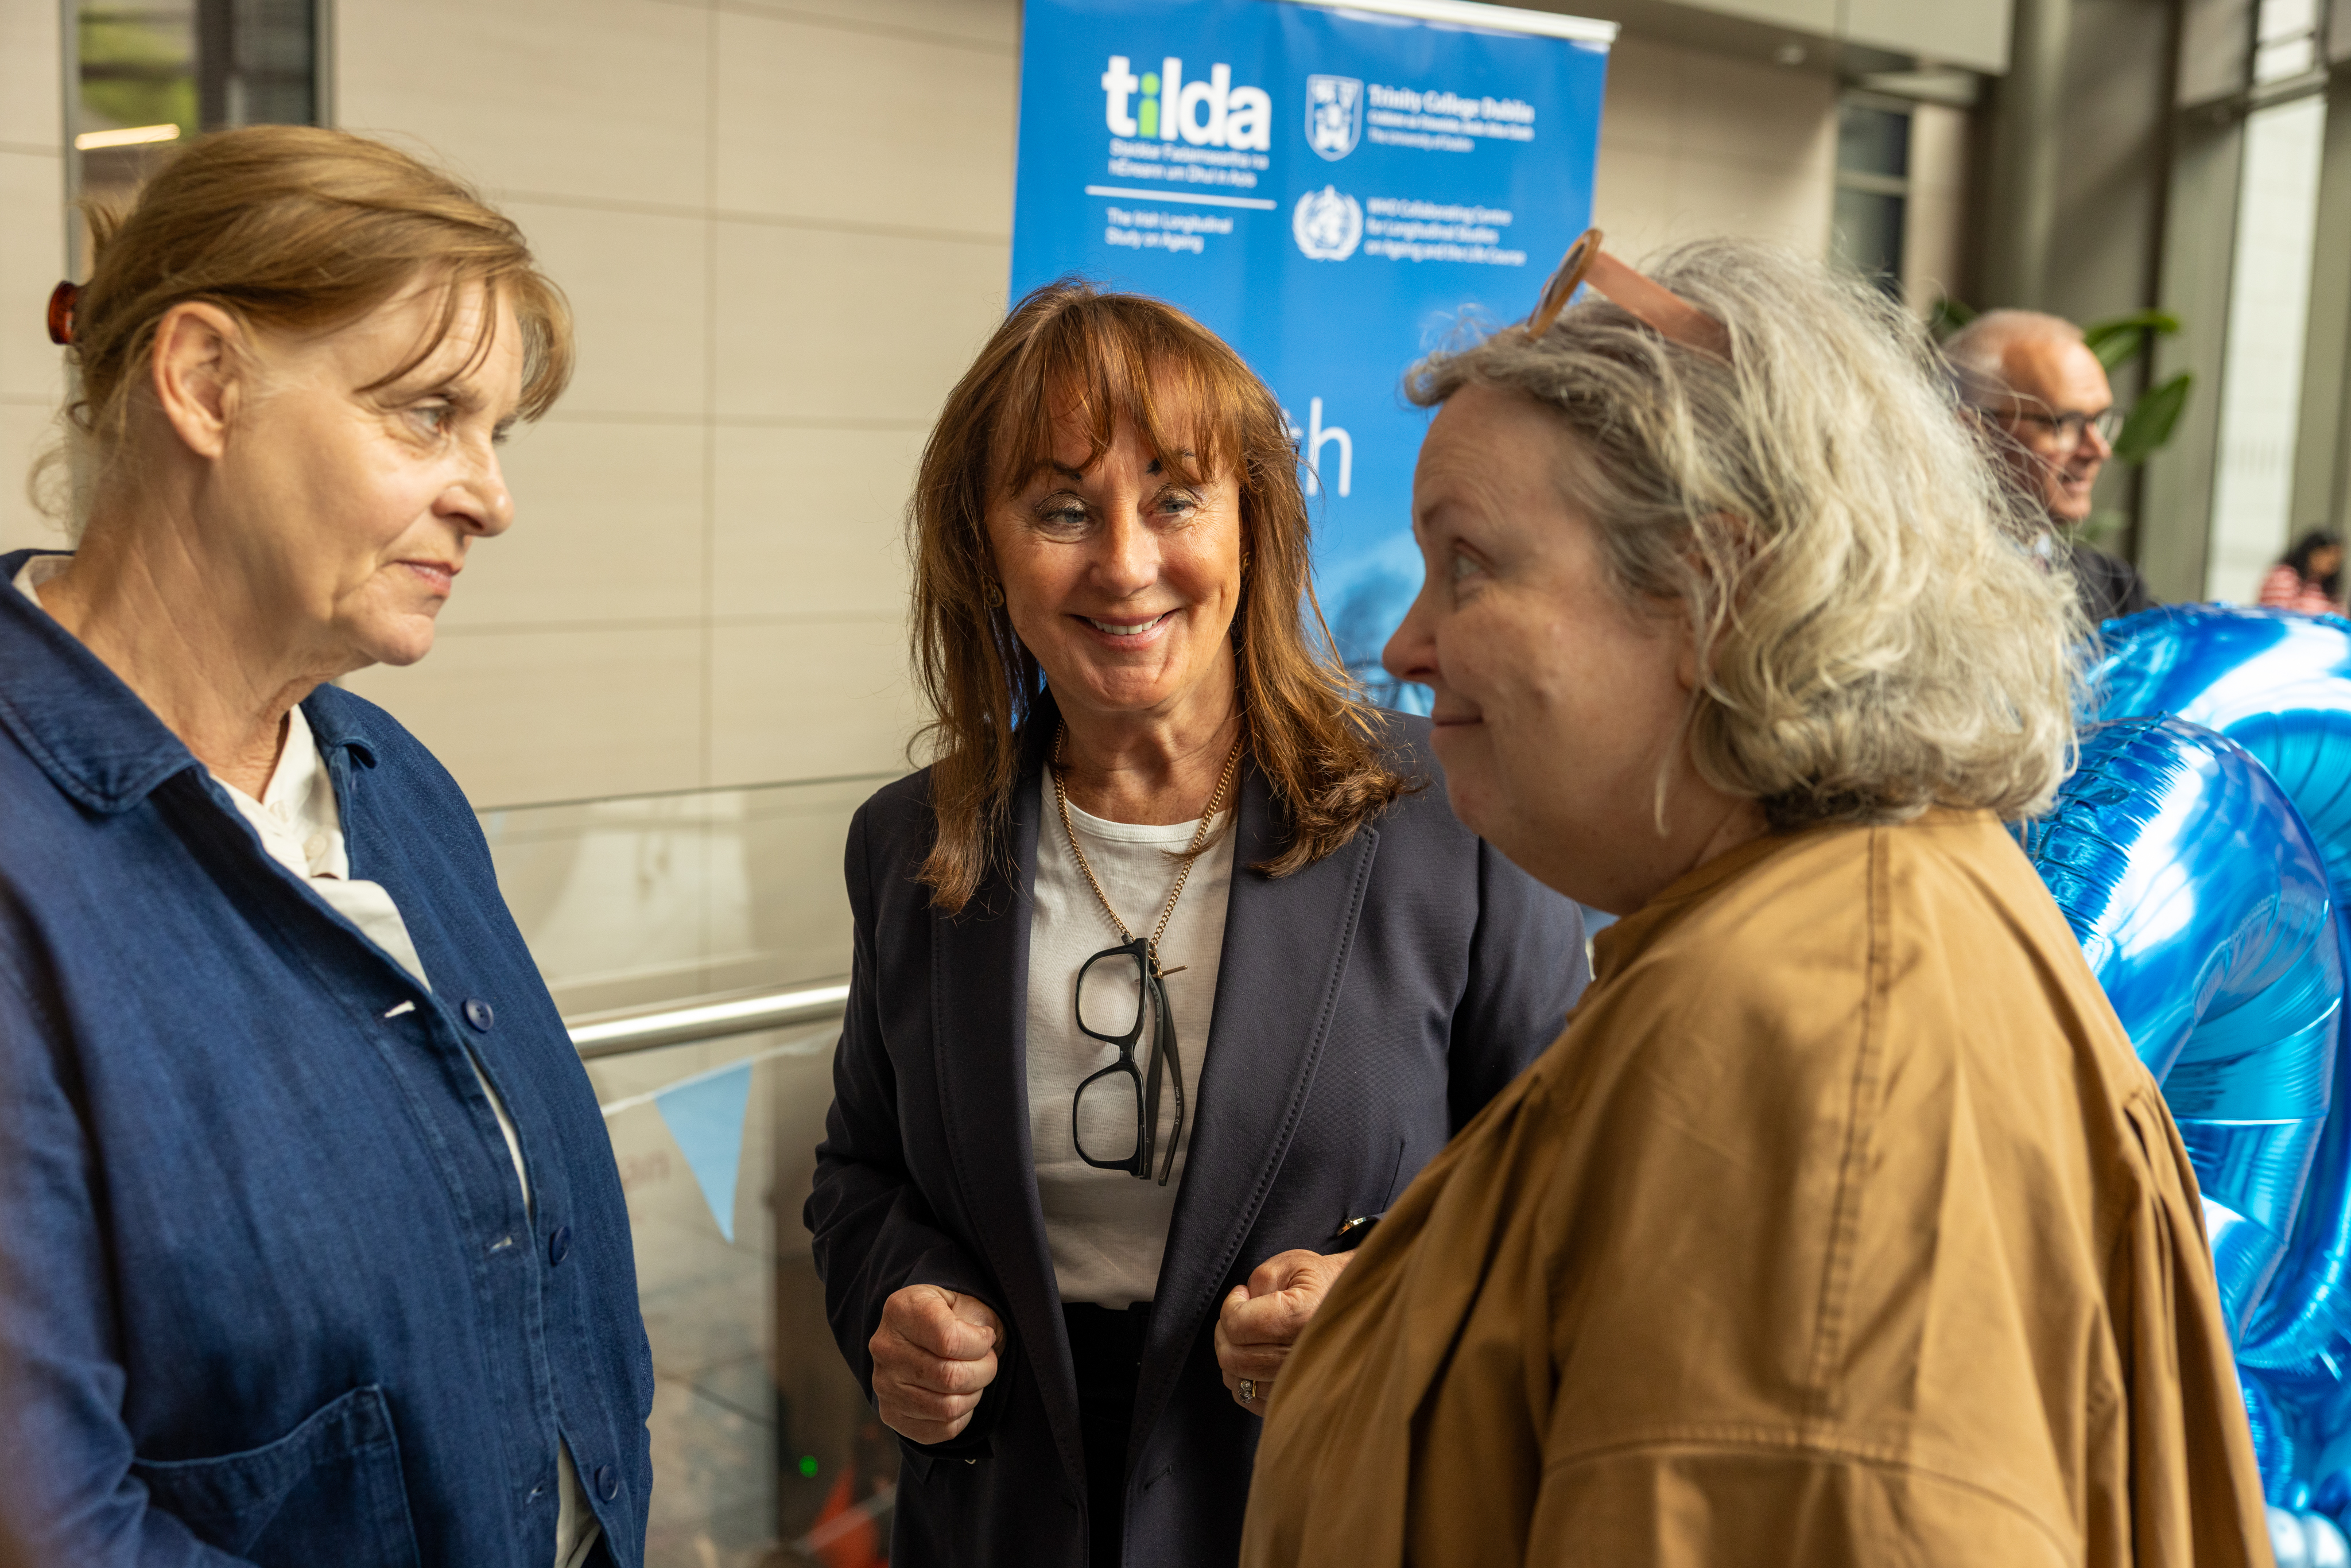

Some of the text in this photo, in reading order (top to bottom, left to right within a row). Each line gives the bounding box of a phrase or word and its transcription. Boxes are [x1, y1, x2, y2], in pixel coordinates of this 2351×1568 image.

[1101, 55, 1271, 151] tilda
[1368, 84, 1534, 123] Trinity College Dublin
[1106, 207, 1132, 226] The
[1161, 212, 1232, 234] Longitudinal
[1105, 227, 1203, 253] Study on Ageing
